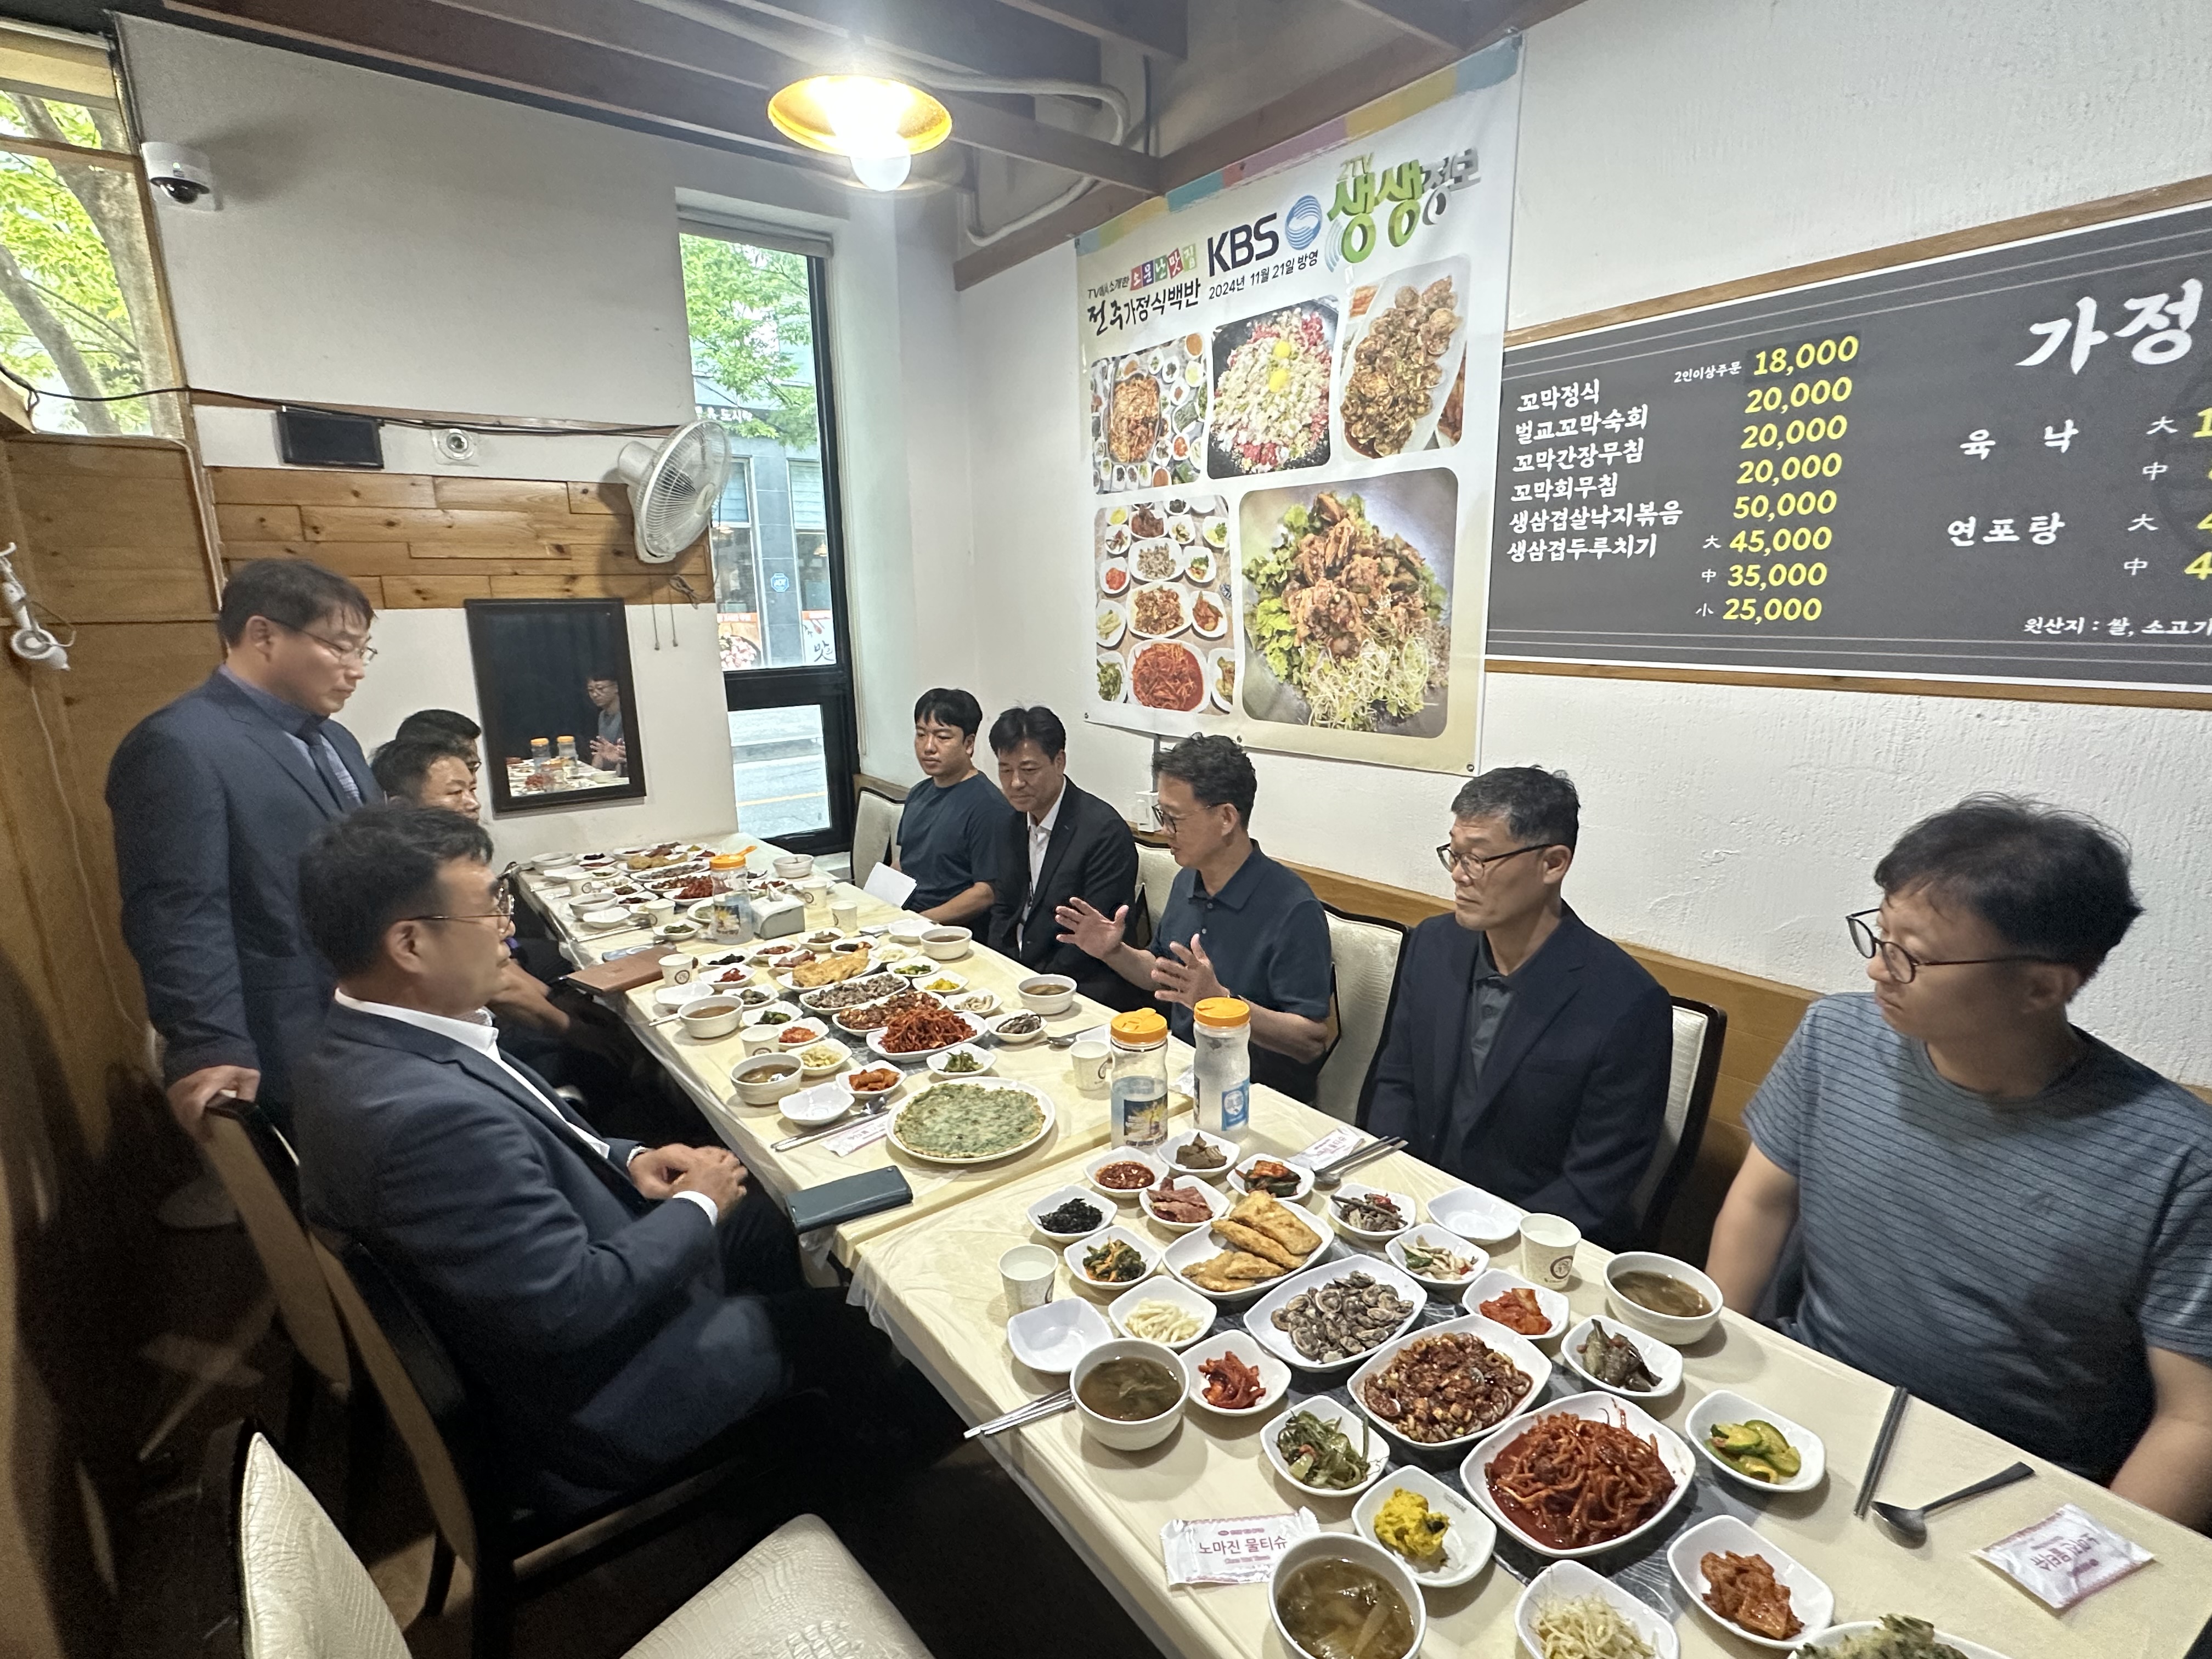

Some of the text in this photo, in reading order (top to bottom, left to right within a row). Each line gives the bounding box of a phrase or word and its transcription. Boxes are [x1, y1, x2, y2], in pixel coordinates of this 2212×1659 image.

[1207, 212, 1279, 278] KBS
[1209, 249, 1319, 300] 2024년 11월 21일 방영
[1516, 336, 1859, 412] 꼬막정식 2인이상주문 18,000
[1515, 376, 1853, 445] 벌교꼬막숙회 20,000
[1512, 415, 1848, 472] 꼬막간장무침 20,000
[1960, 429, 1996, 460] 육
[2044, 419, 2079, 453] 낙
[2146, 416, 2178, 435] 大
[1510, 452, 1842, 503] 꼬막회무침 20,000
[2142, 461, 2168, 481] 中
[1509, 489, 1837, 534] 생삼겹살낙지볶음 50,000
[1948, 512, 2066, 546] 연포탕
[2128, 514, 2158, 532] 大
[1506, 526, 1832, 563] 생삼겹두루치기 大 45,000
[1701, 562, 1827, 591] 中 35,000
[2124, 557, 2148, 575] 中
[1695, 597, 1822, 625] 小 25,000
[2024, 617, 2085, 634] 원산지
[2107, 617, 2134, 637] 쌀,
[1199, 1535, 1288, 1555] 노마진 물티슈
